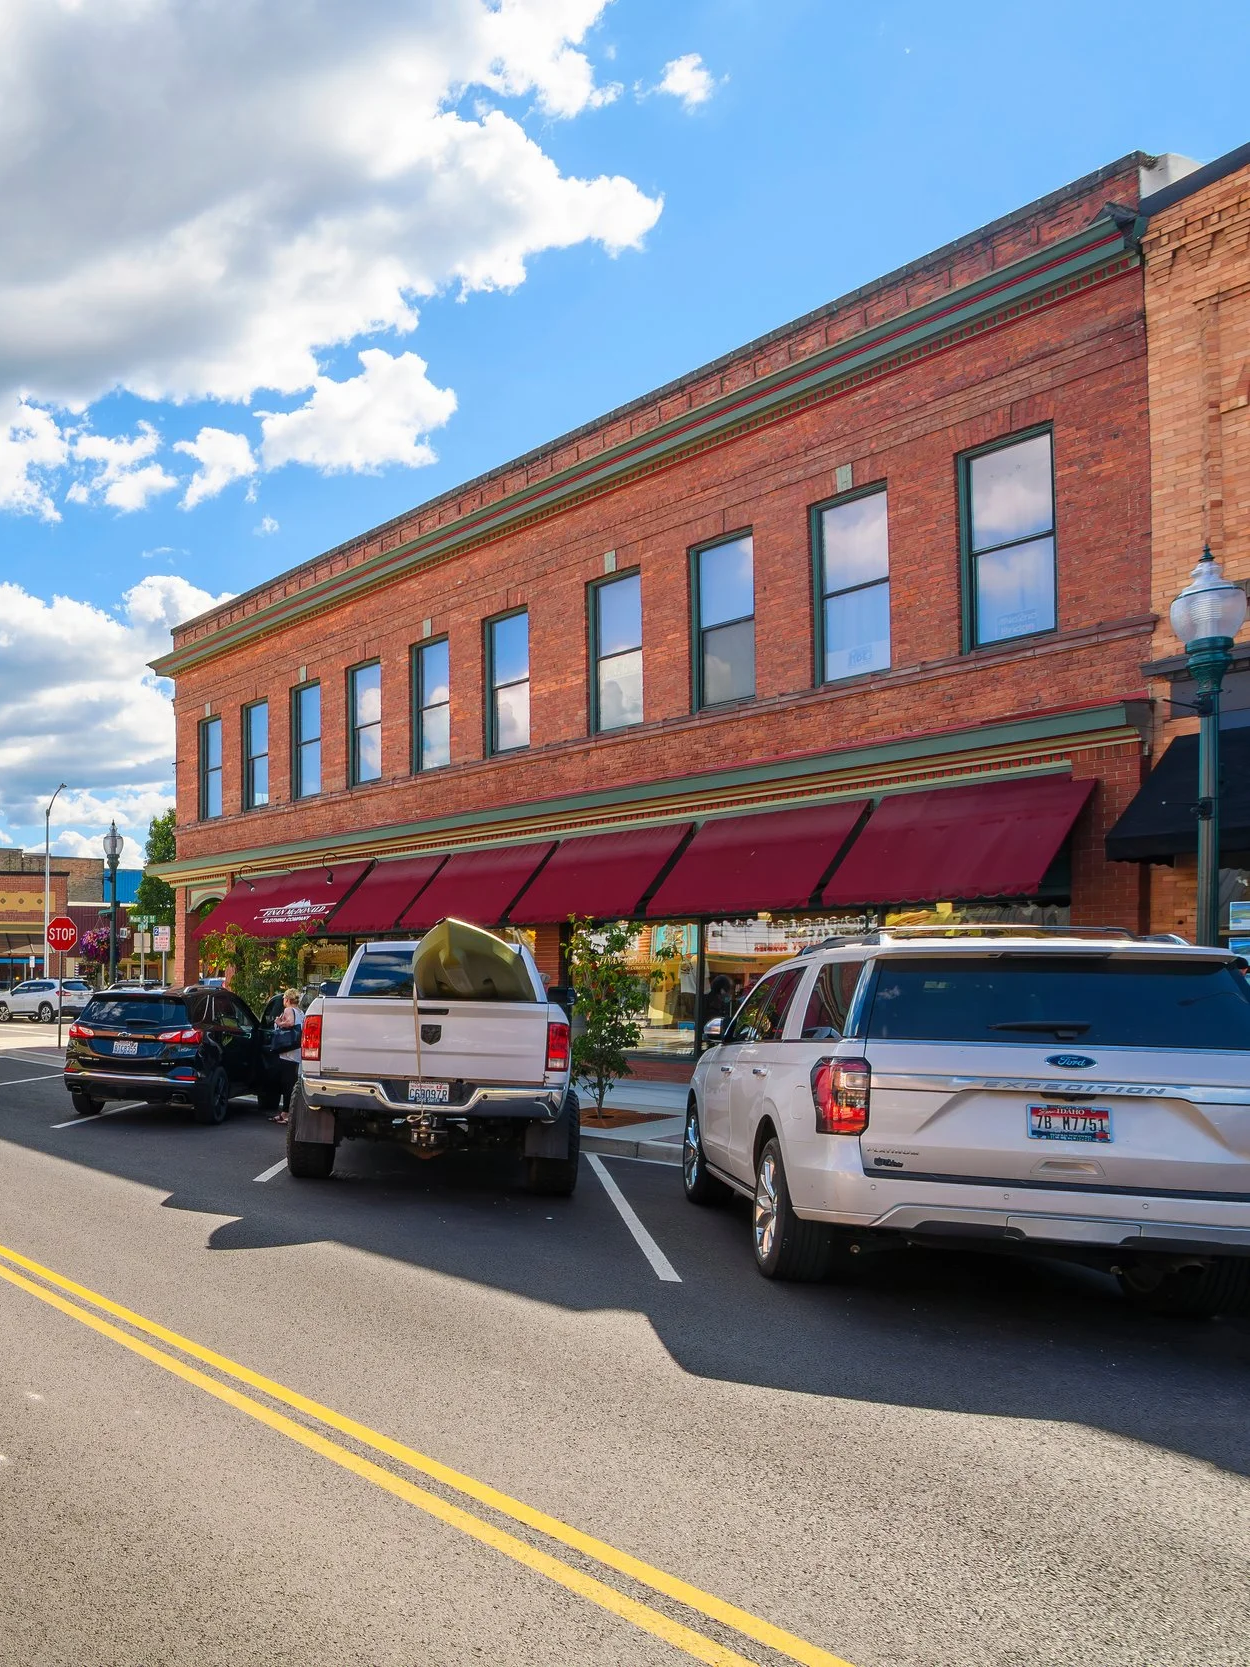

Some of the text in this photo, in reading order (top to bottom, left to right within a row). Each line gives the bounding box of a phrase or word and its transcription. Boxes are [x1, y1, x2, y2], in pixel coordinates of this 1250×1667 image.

[48, 927, 76, 941] STOP
[1057, 1055, 1087, 1067] Ford
[983, 1081, 1166, 1096] EXPEDITION
[1056, 1107, 1085, 1116] IDAHO
[1037, 1115, 1105, 1132] 7B M7751
